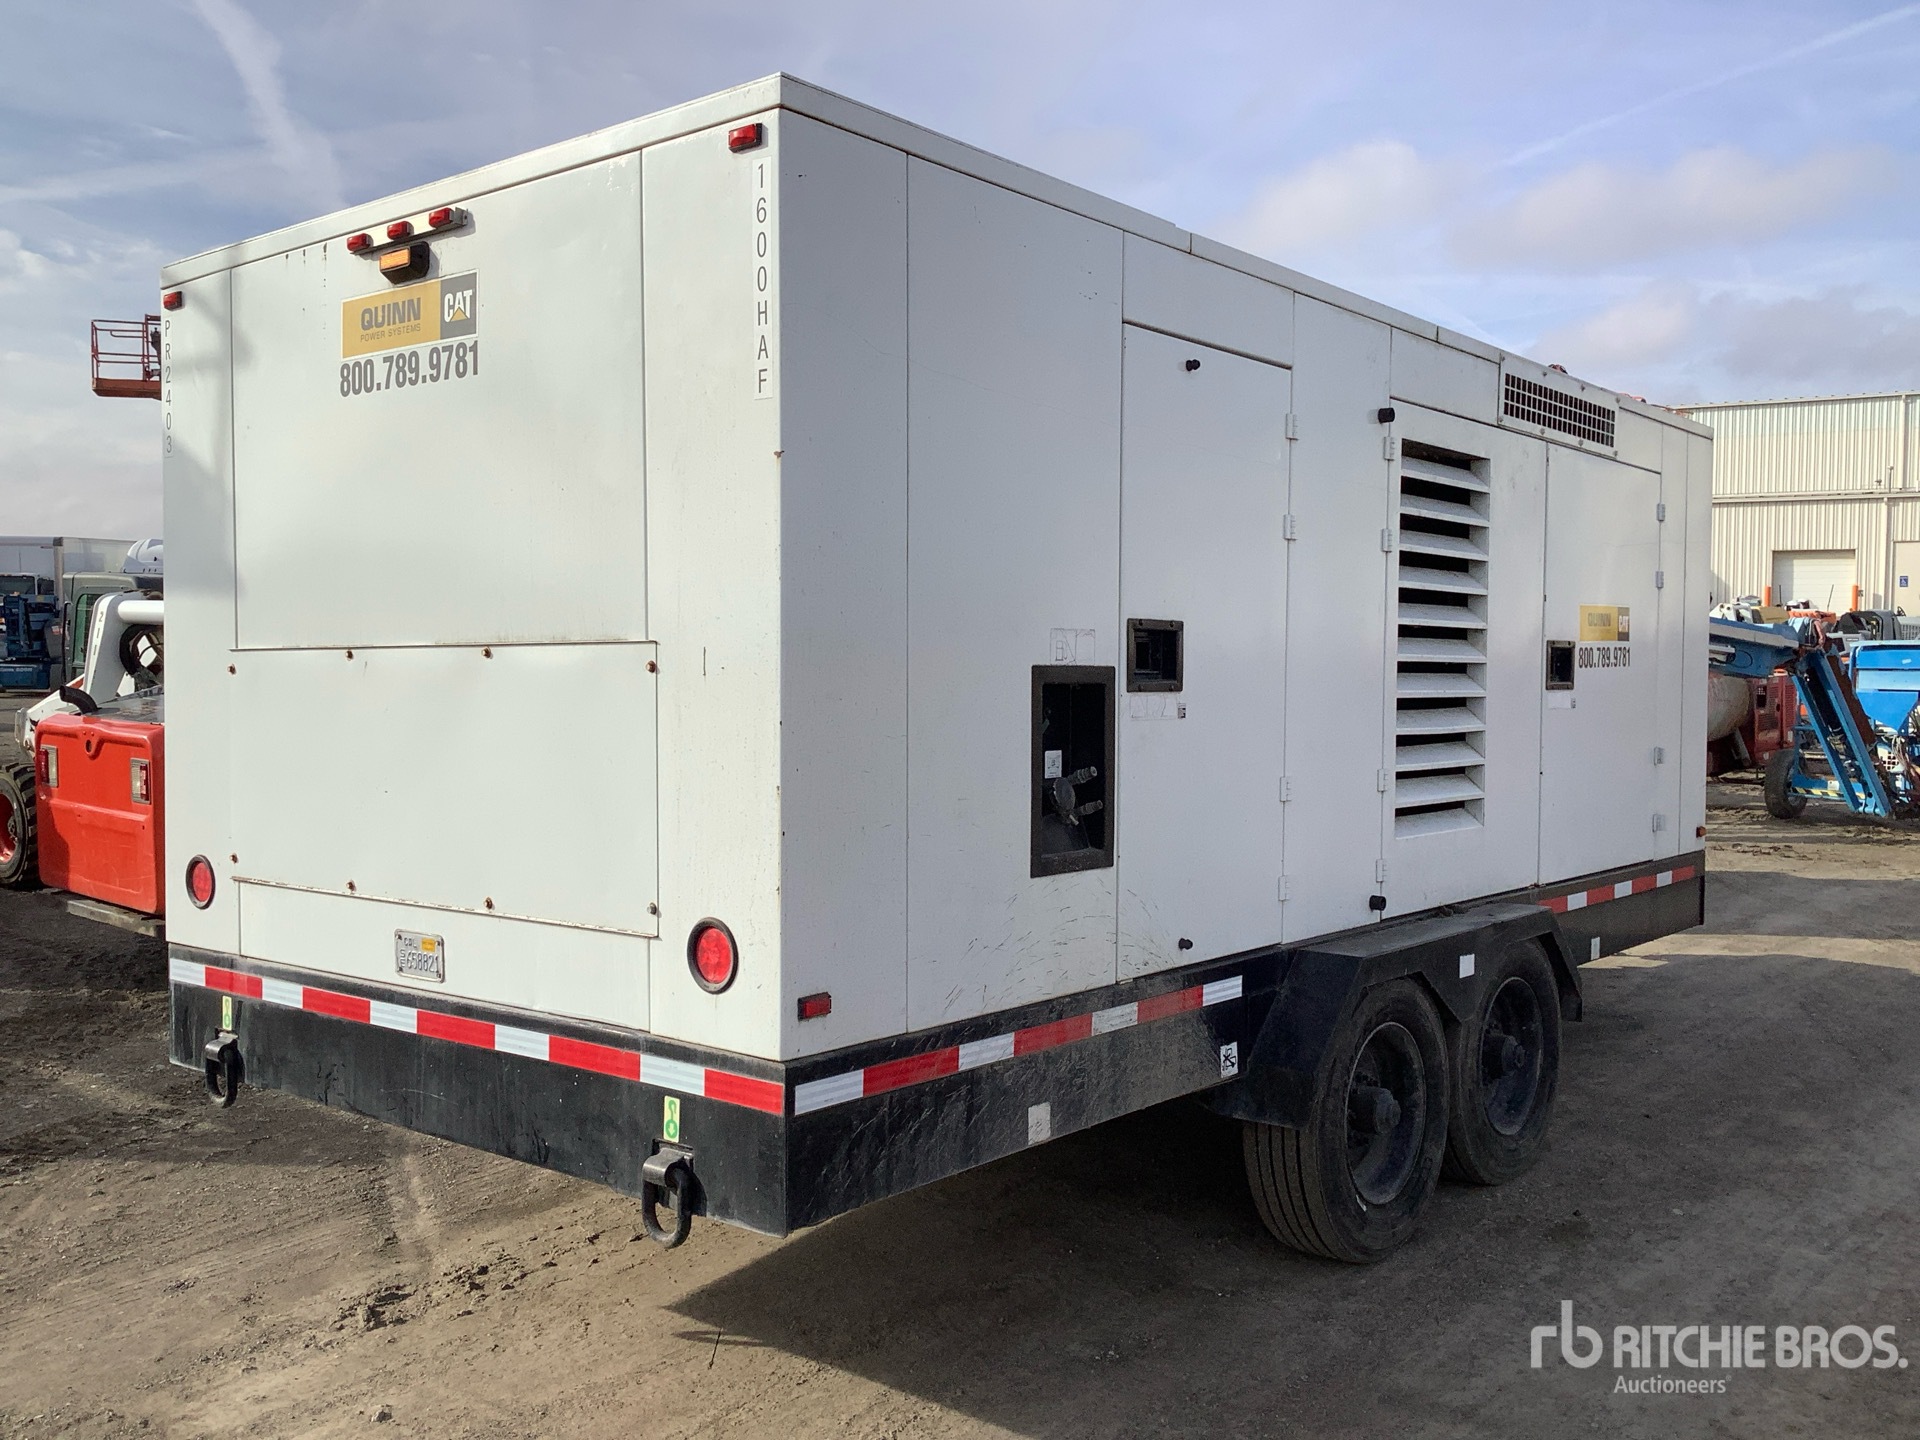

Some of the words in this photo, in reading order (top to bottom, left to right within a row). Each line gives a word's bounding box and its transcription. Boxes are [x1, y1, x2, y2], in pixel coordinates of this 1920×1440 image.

[755, 163, 769, 394] 1600HAF
[360, 297, 422, 331] QUINN
[444, 288, 473, 323] CAT
[360, 331, 386, 343] POWER
[388, 323, 421, 338] SYSTEMS
[340, 340, 479, 397] 800.789.9781
[1588, 613, 1611, 626] QUINN
[1618, 615, 1629, 632] CAT
[1579, 647, 1630, 668] 800.789.9781
